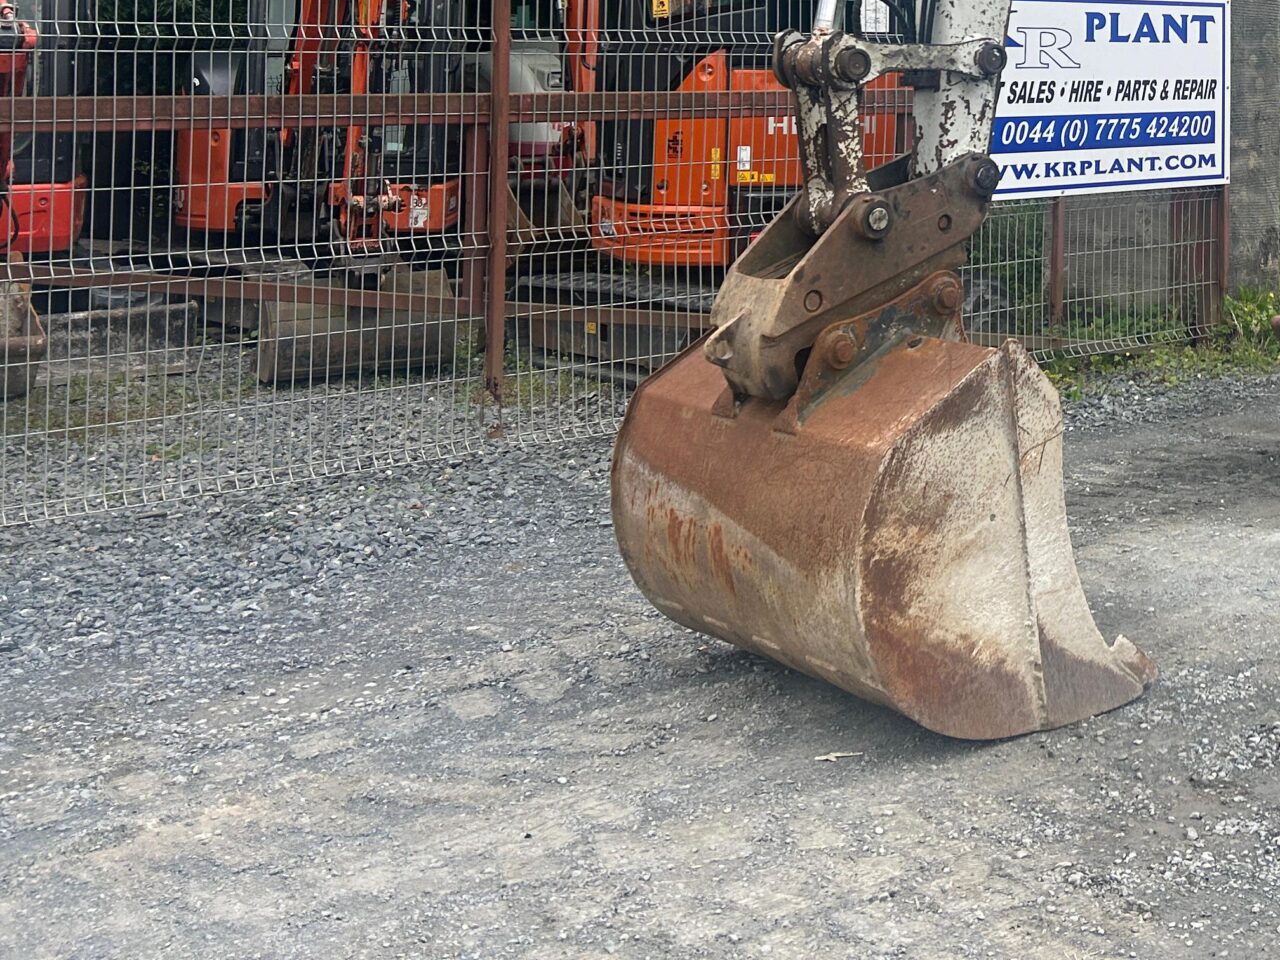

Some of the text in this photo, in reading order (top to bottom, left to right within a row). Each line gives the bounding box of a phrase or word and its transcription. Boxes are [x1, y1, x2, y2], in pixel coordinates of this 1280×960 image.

[1084, 11, 1216, 44] PLANT
[1007, 79, 1217, 104] SALES HIRE PARTS & REPAIR
[1001, 115, 1212, 148] 0044 (0) 7775 424200
